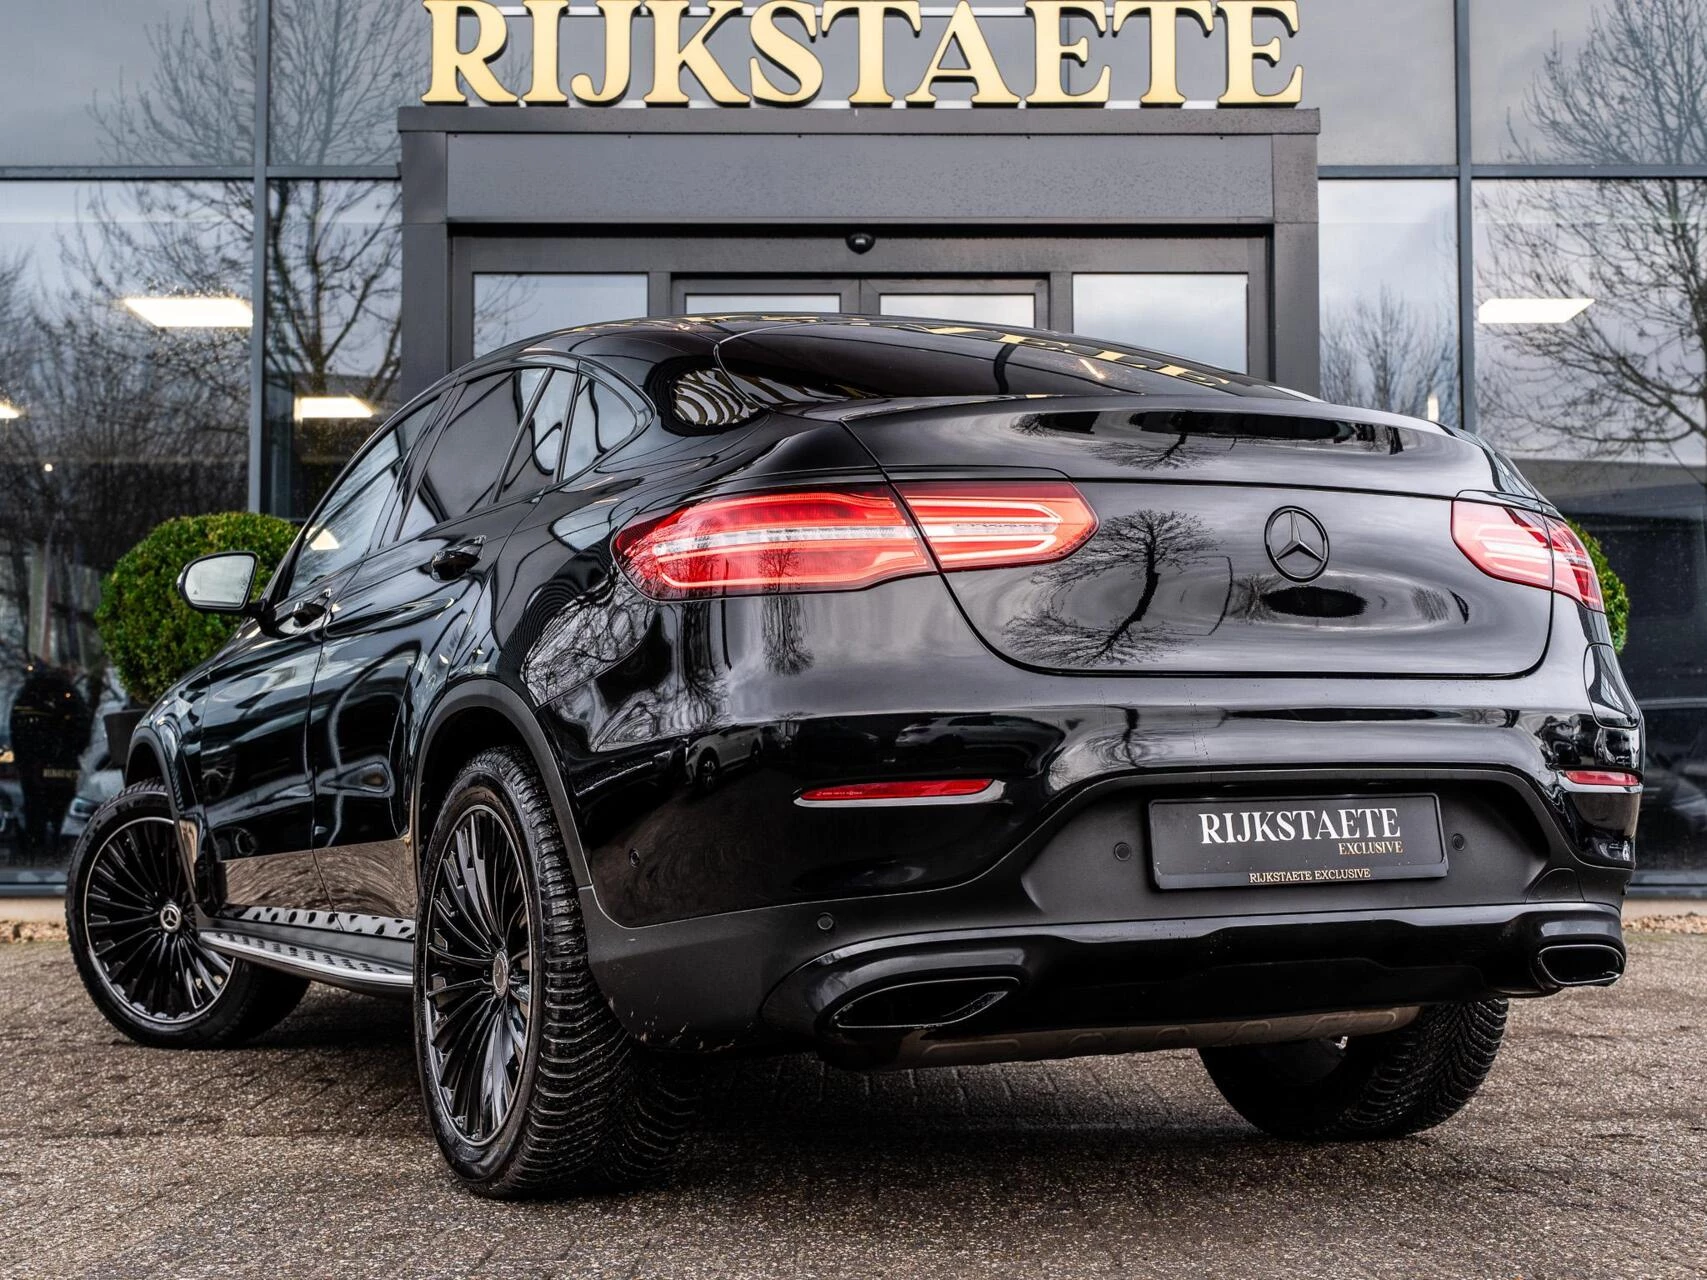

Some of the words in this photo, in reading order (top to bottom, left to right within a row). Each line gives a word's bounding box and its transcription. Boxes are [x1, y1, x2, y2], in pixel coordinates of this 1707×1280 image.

[420, 0, 1304, 107] RIJKSTAETE
[1198, 808, 1401, 844] RIJKSTAETE
[1338, 841, 1404, 855] EXCLUSIVE
[1249, 871, 1312, 883] RIJKSTAETE
[1314, 868, 1371, 880] EXCLUSIVE
